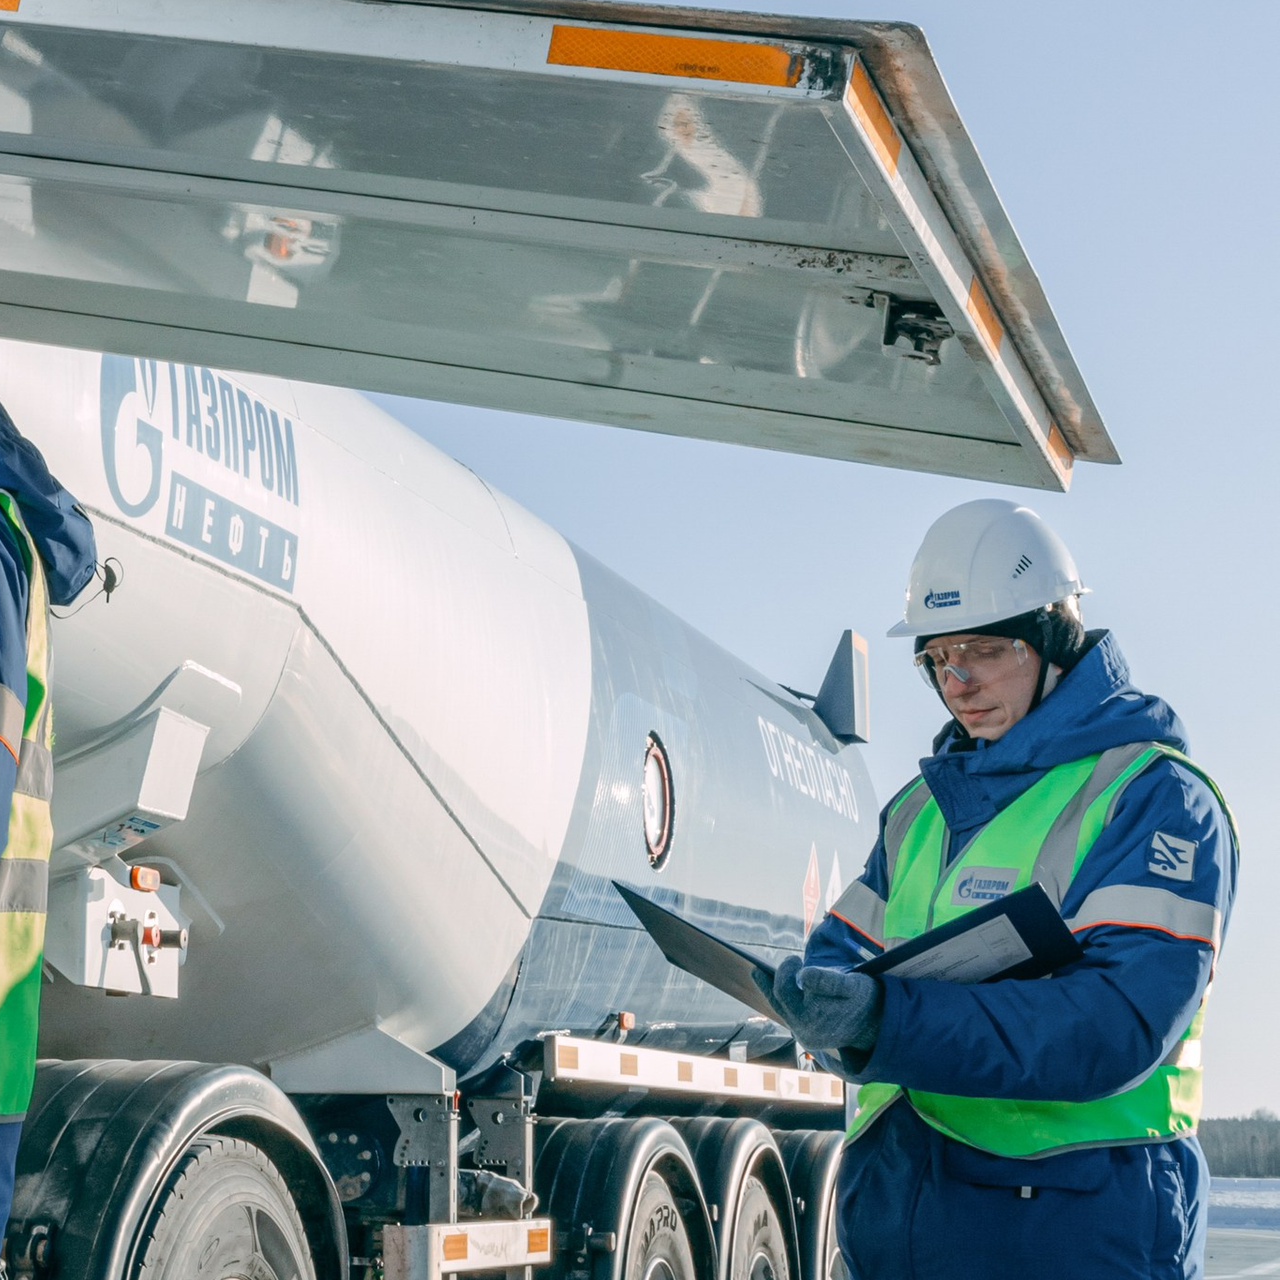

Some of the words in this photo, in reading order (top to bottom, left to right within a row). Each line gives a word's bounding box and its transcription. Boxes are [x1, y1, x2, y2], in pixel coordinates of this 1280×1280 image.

[169, 361, 299, 508] ГАЗПРОМ
[172, 483, 292, 582] НЕФТЬ
[758, 715, 859, 824] ОГНЕОПАСНО
